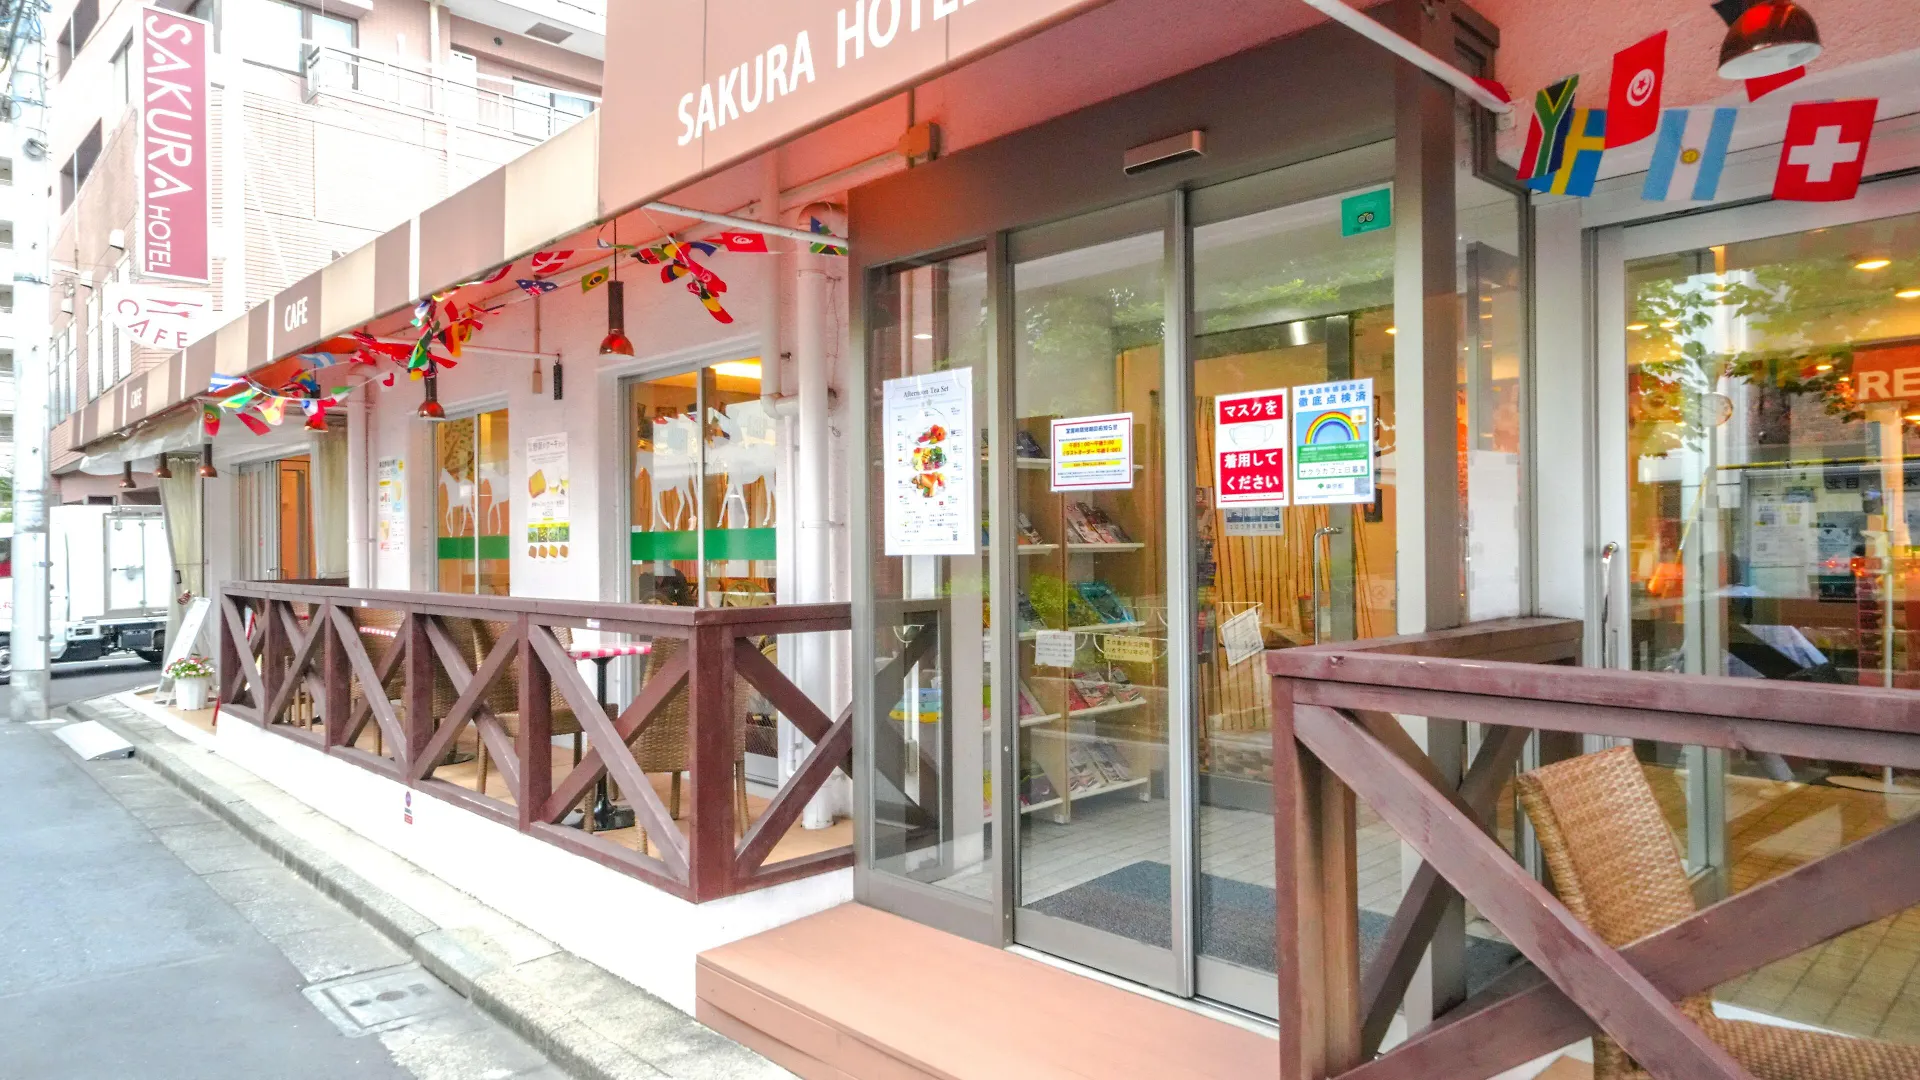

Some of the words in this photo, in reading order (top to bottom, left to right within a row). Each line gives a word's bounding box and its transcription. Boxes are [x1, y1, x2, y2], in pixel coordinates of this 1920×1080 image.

[677, 30, 816, 146] SAKURA
[836, 0, 978, 69] HOT
[145, 15, 192, 199] SAKURA
[148, 204, 171, 274] HOTEL
[117, 299, 188, 349] CAFE
[284, 296, 308, 332] CAFE
[903, 389, 929, 398] Afternon
[1299, 391, 1366, 407] 徹底点検済
[1224, 401, 1278, 417] マスクを
[1224, 452, 1278, 468] 着用して
[1227, 475, 1279, 490] ください
